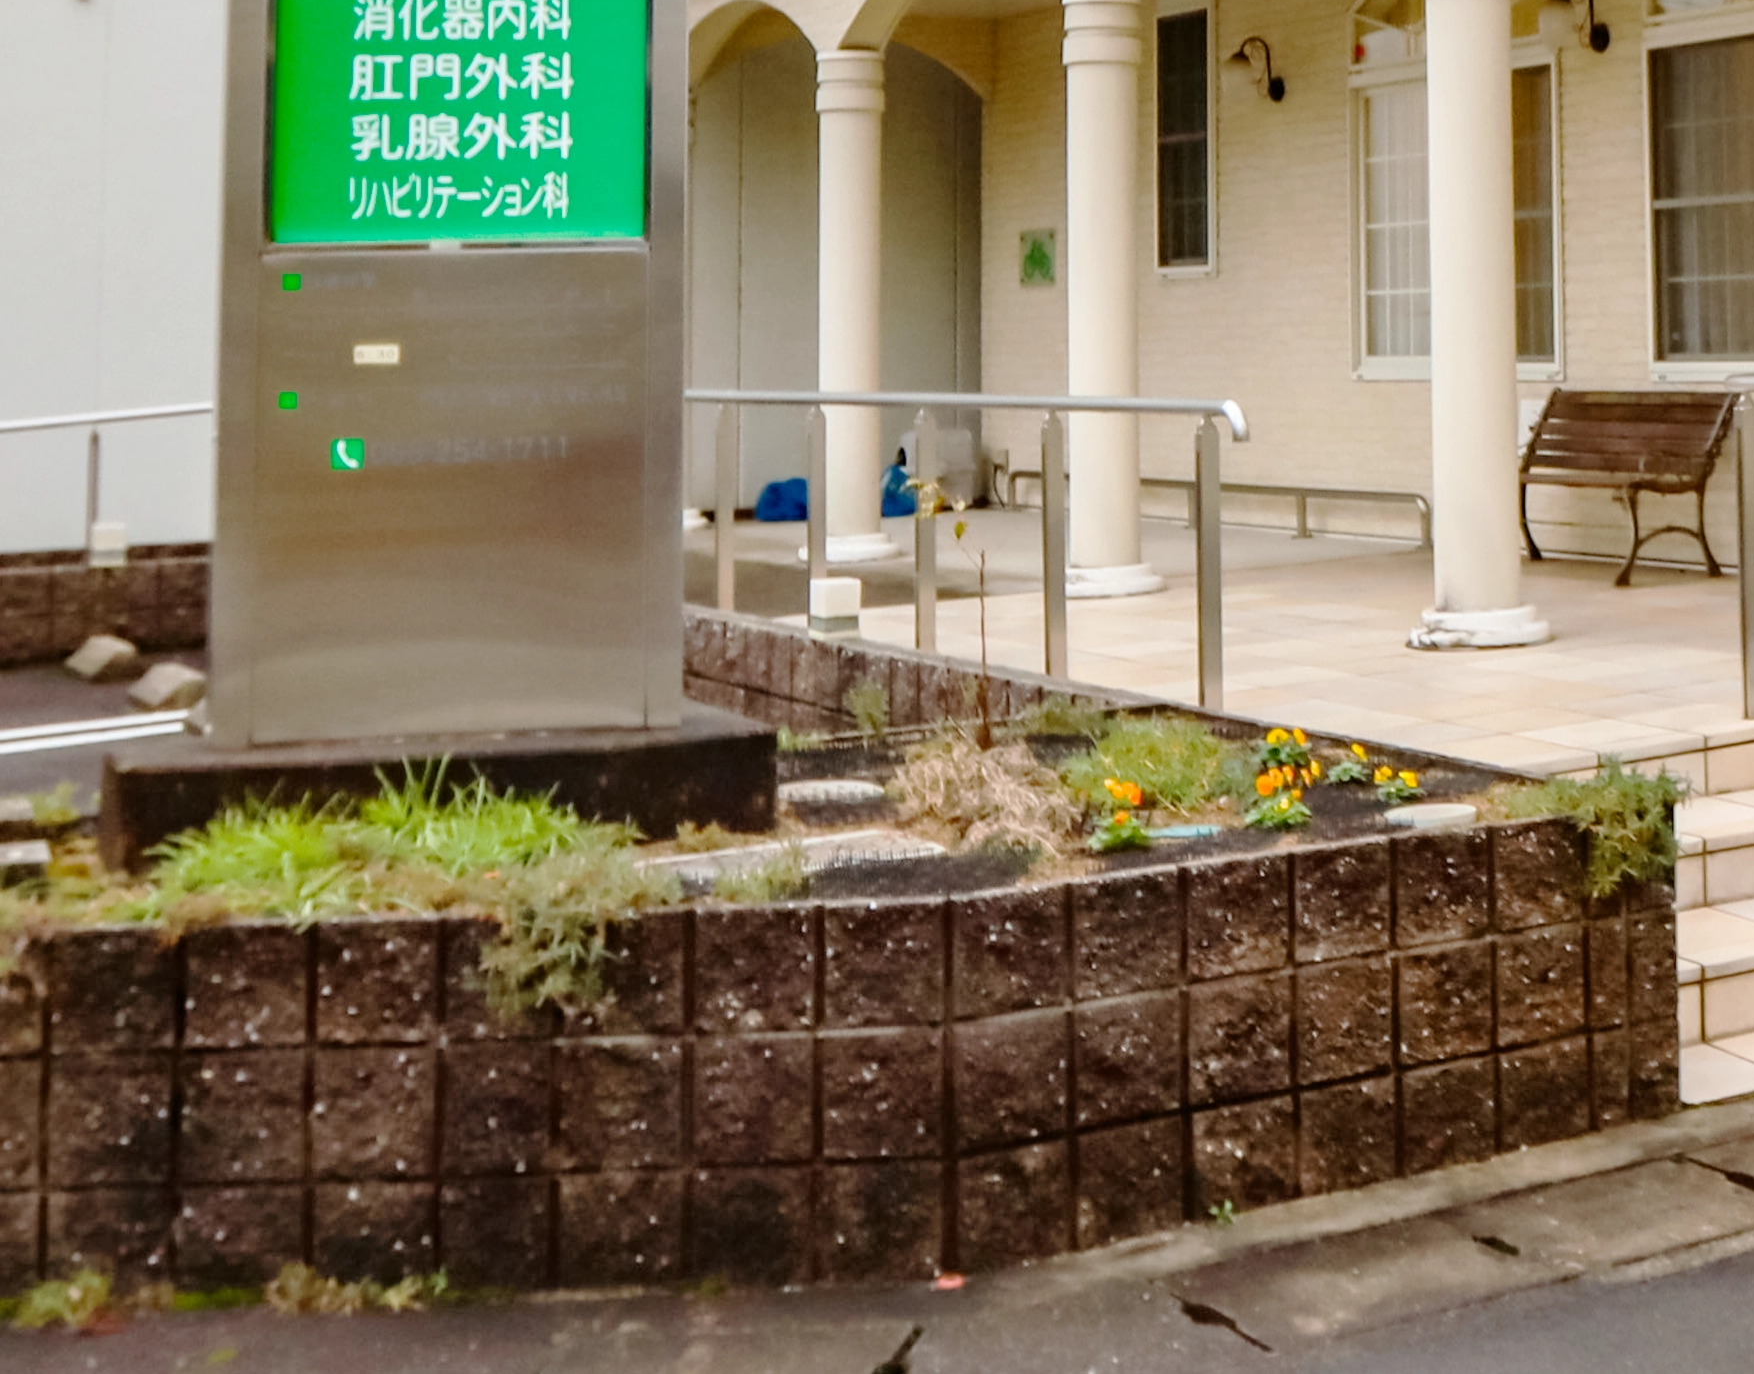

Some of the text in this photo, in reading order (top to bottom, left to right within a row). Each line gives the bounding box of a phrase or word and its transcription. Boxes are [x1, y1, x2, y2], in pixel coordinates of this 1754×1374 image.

[349, 52, 574, 101] 肛門外科
[350, 111, 573, 161] 乳腺外科
[348, 171, 570, 220] リハビリテーション科
